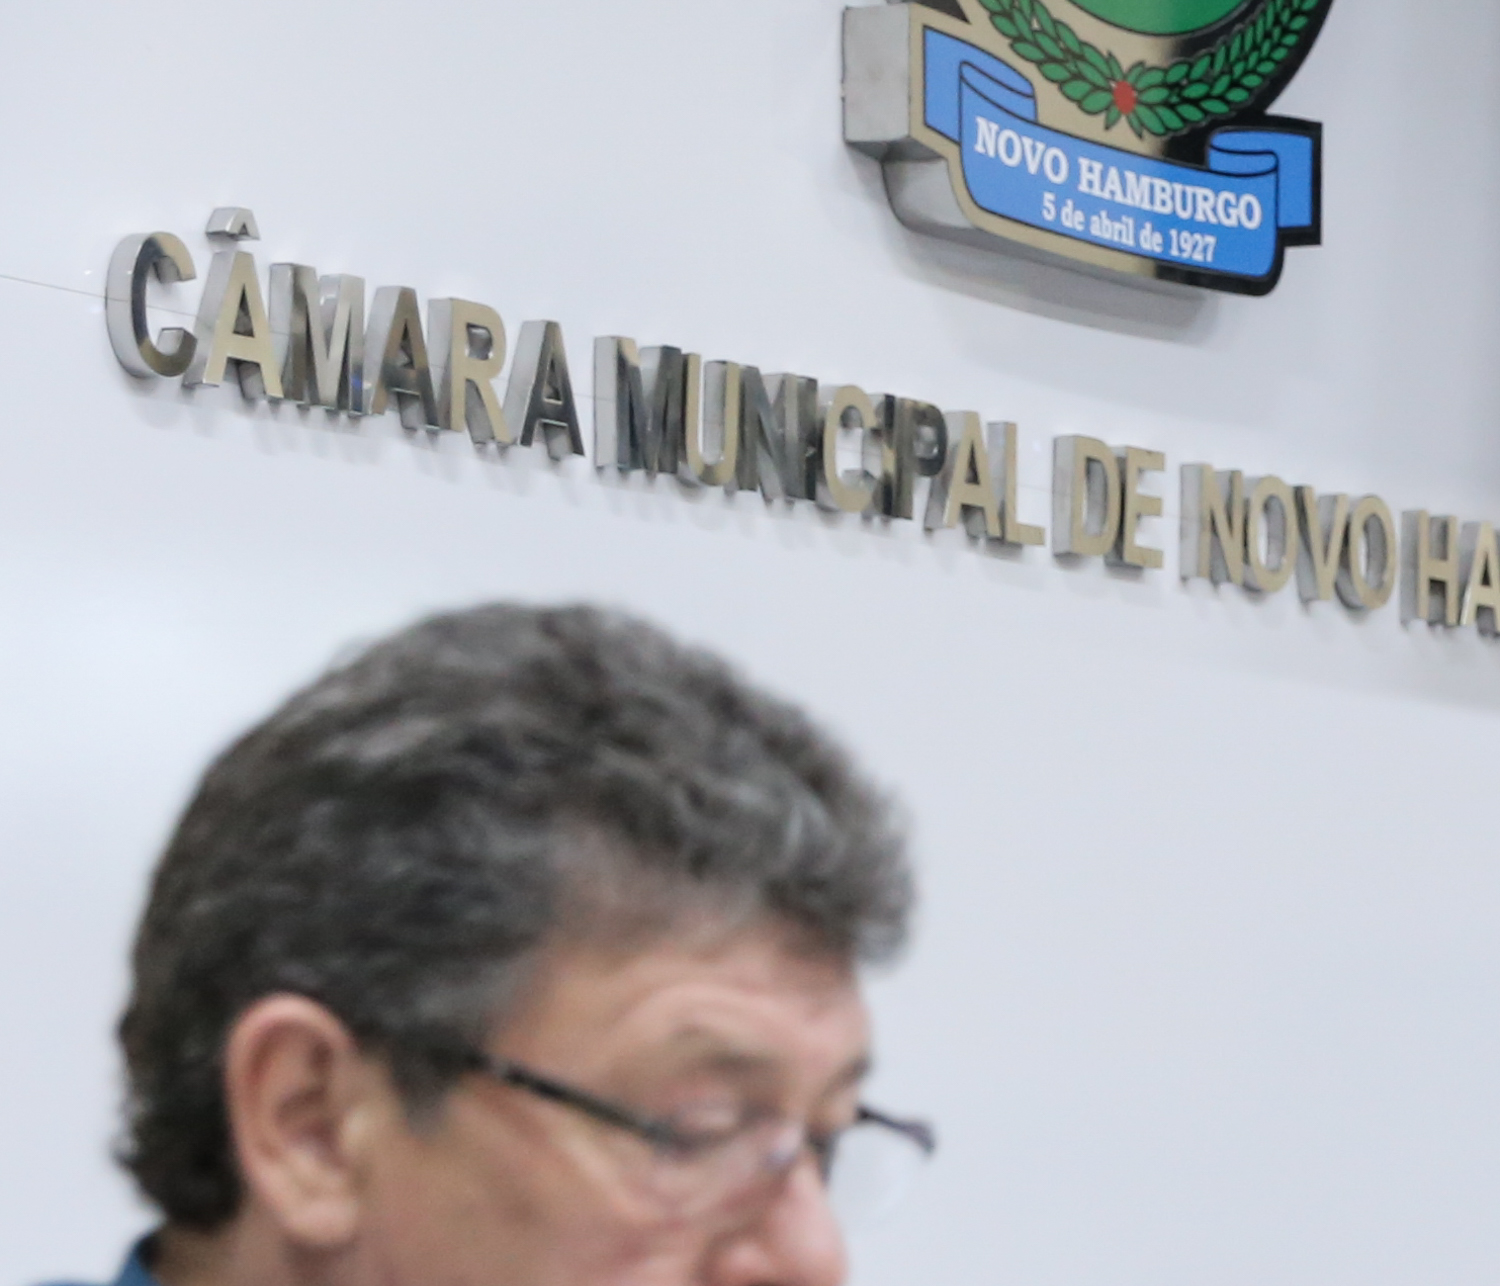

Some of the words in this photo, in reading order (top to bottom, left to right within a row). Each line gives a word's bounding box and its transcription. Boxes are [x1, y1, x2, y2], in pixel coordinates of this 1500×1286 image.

[974, 115, 1069, 186] NOVO
[1077, 155, 1263, 231] HAMBURGO
[1041, 191, 1056, 223] 5
[1060, 196, 1086, 233] de
[1089, 208, 1135, 249] abril
[1138, 221, 1164, 254] de
[1169, 227, 1218, 264] 1927
[106, 206, 586, 462] CÂMARA
[593, 335, 1046, 547] MUNICIPAL
[1052, 434, 1167, 571] DE
[1179, 462, 1398, 612] NOVO
